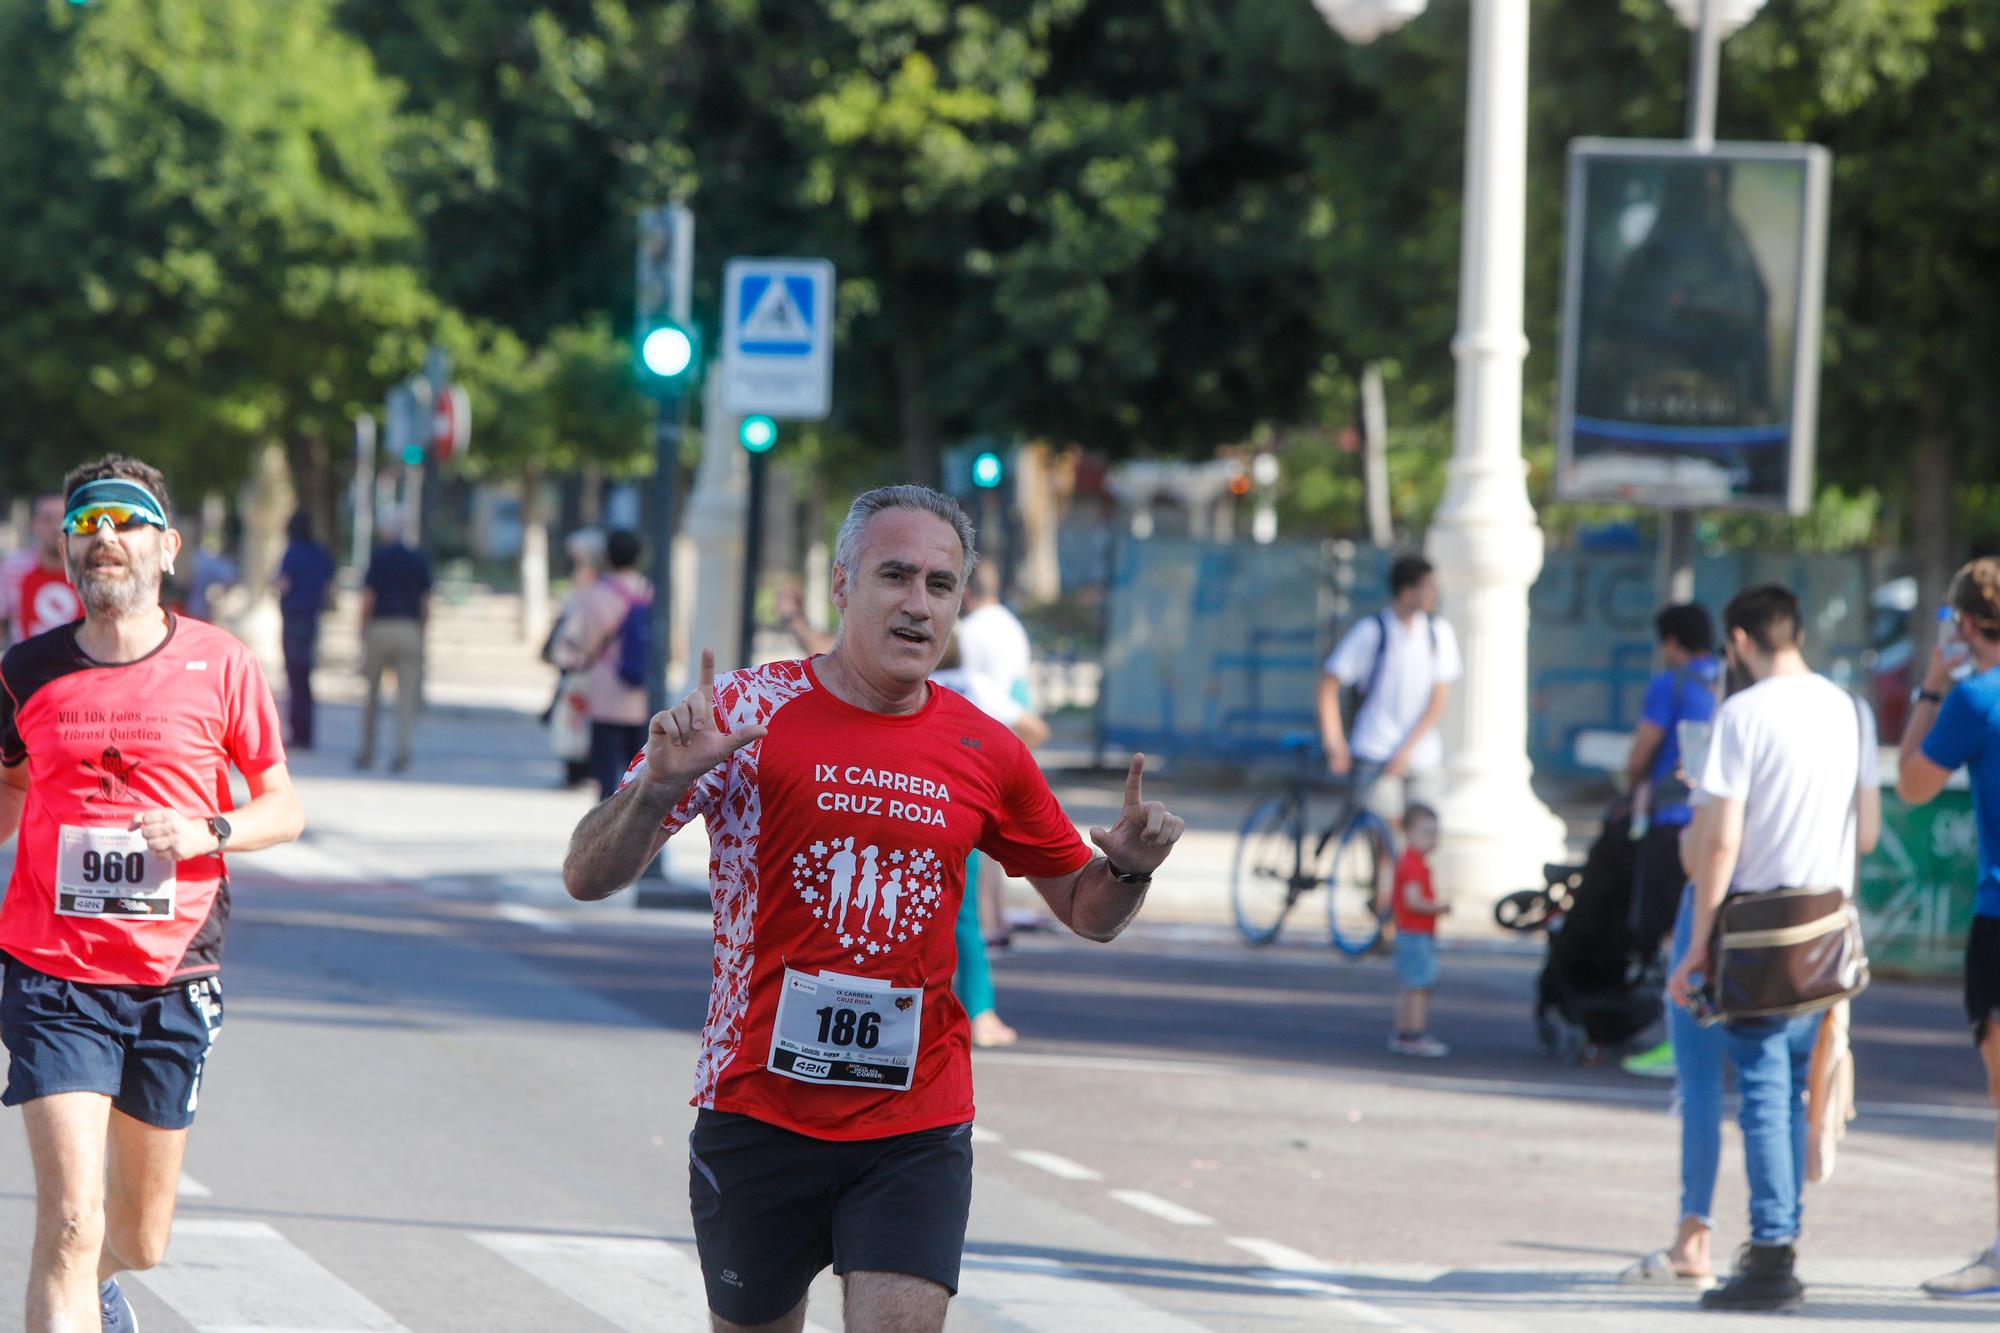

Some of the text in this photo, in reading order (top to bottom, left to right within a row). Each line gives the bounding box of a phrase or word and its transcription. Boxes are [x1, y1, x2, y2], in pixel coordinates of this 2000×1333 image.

[59, 711, 78, 723] VIII
[84, 710, 105, 723] 10k
[64, 728, 105, 741] Fibrosi
[815, 764, 951, 802] IX CARRERA
[816, 792, 947, 828] CRUZ ROJA
[83, 850, 144, 884] 960
[844, 991, 873, 999] CARRERA
[816, 1006, 881, 1049] 186
[795, 1061, 827, 1074] 42K
